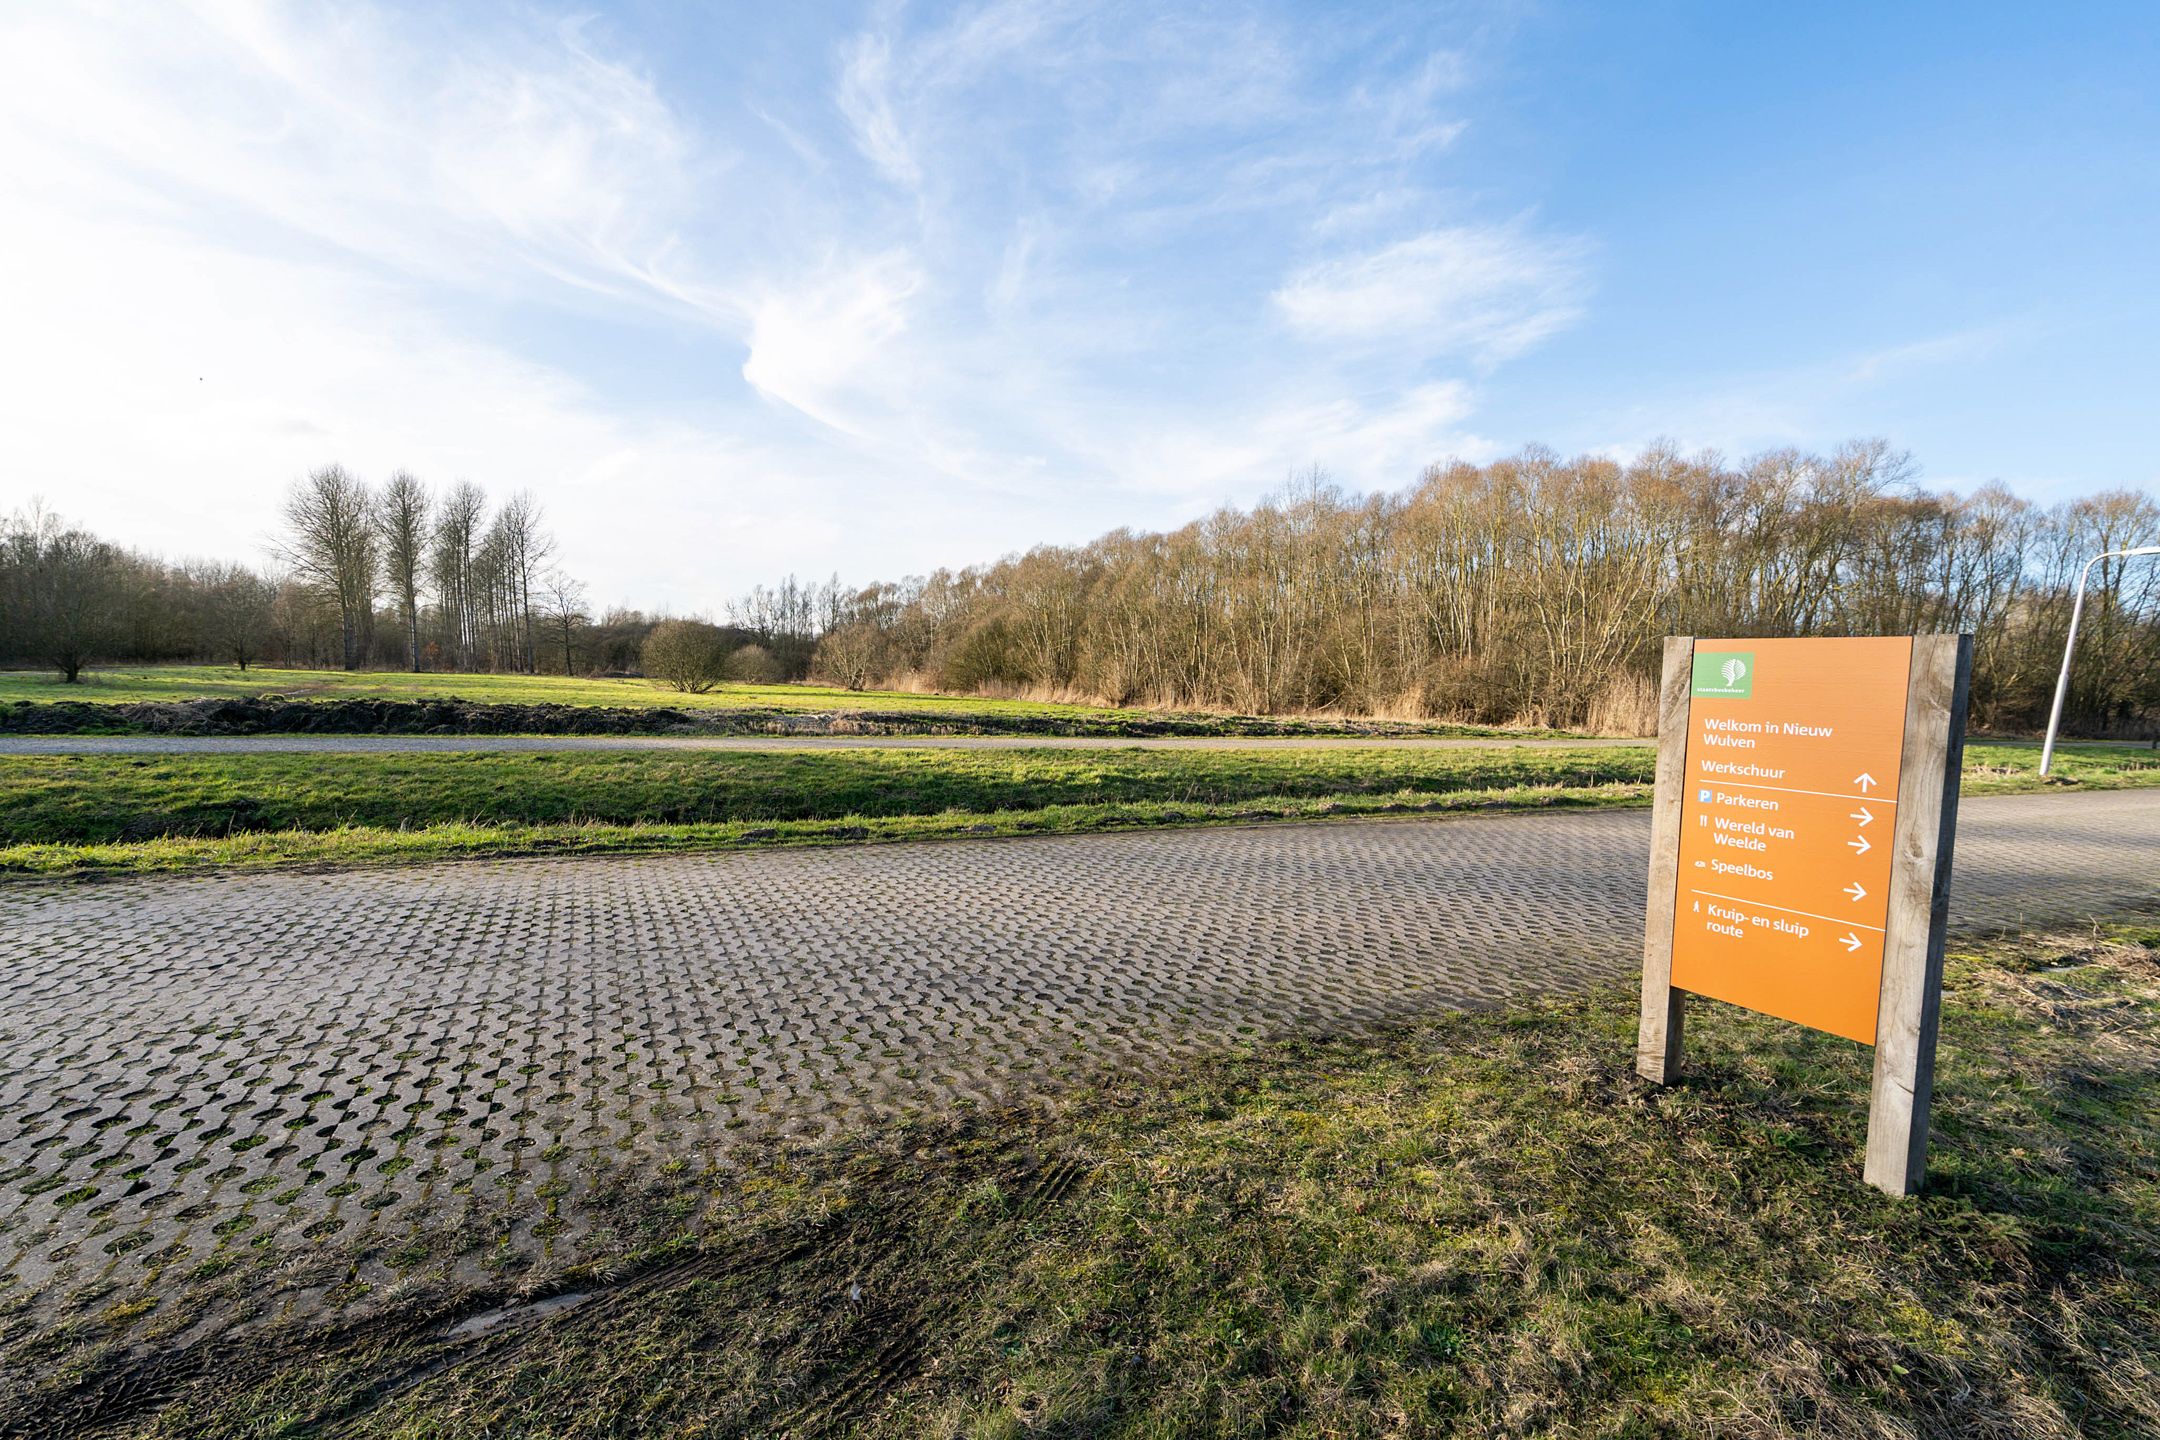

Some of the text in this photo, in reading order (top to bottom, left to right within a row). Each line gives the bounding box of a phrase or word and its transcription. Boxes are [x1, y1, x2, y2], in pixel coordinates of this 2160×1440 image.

[1704, 718, 1832, 737] Welkom in Nieuw
[1703, 734, 1755, 749] Wulven
[1701, 760, 1785, 779] Werkschuur
[1700, 791, 1779, 811] P Parkeren
[1714, 817, 1795, 839] Wereld van
[1713, 833, 1766, 852] Weelde
[1711, 859, 1773, 880] Speelbos
[1707, 922, 1743, 938] route
[1708, 905, 1809, 939] Kruip- en sluip
